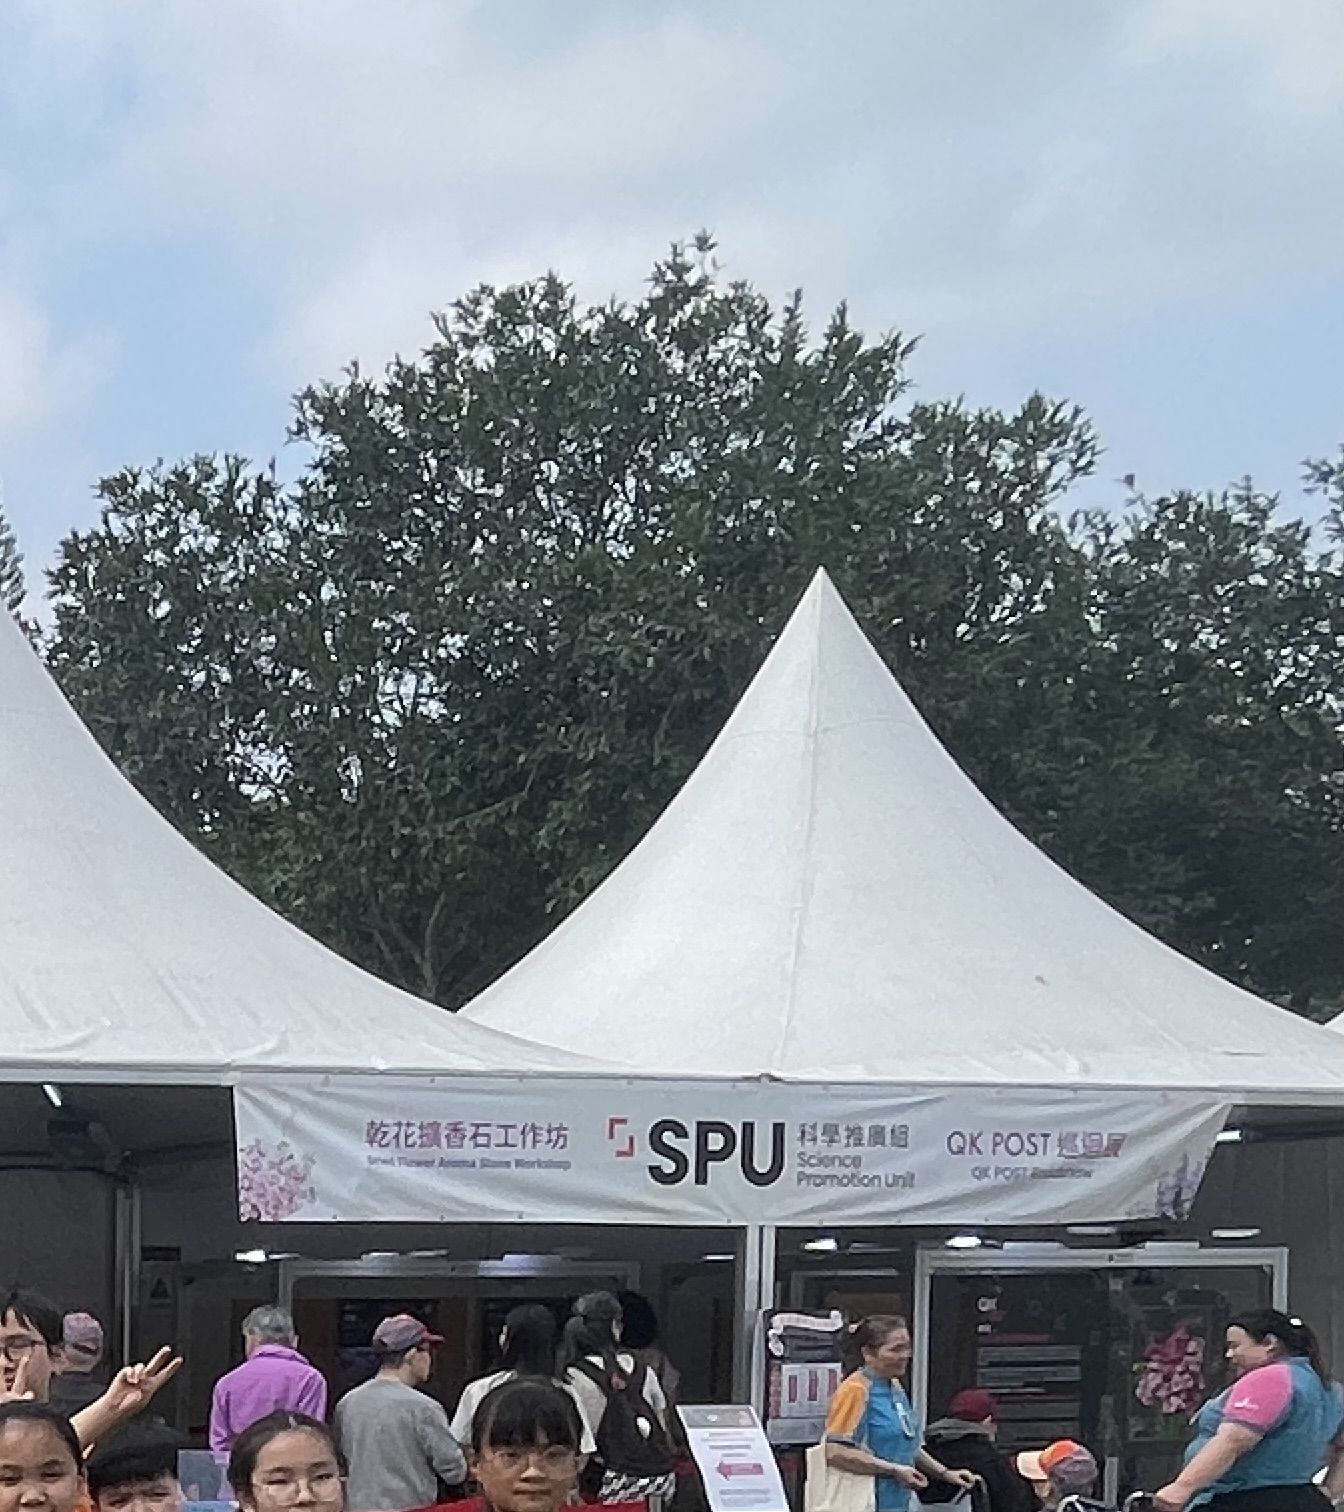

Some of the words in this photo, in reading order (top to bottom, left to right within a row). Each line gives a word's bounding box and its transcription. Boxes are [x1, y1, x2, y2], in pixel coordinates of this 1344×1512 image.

[648, 1118, 786, 1187] SPU
[946, 1130, 984, 1157] QK
[992, 1132, 1052, 1157] POST
[796, 1151, 863, 1170] Science
[797, 1170, 882, 1188] Promotion
[885, 1171, 916, 1188] Unit
